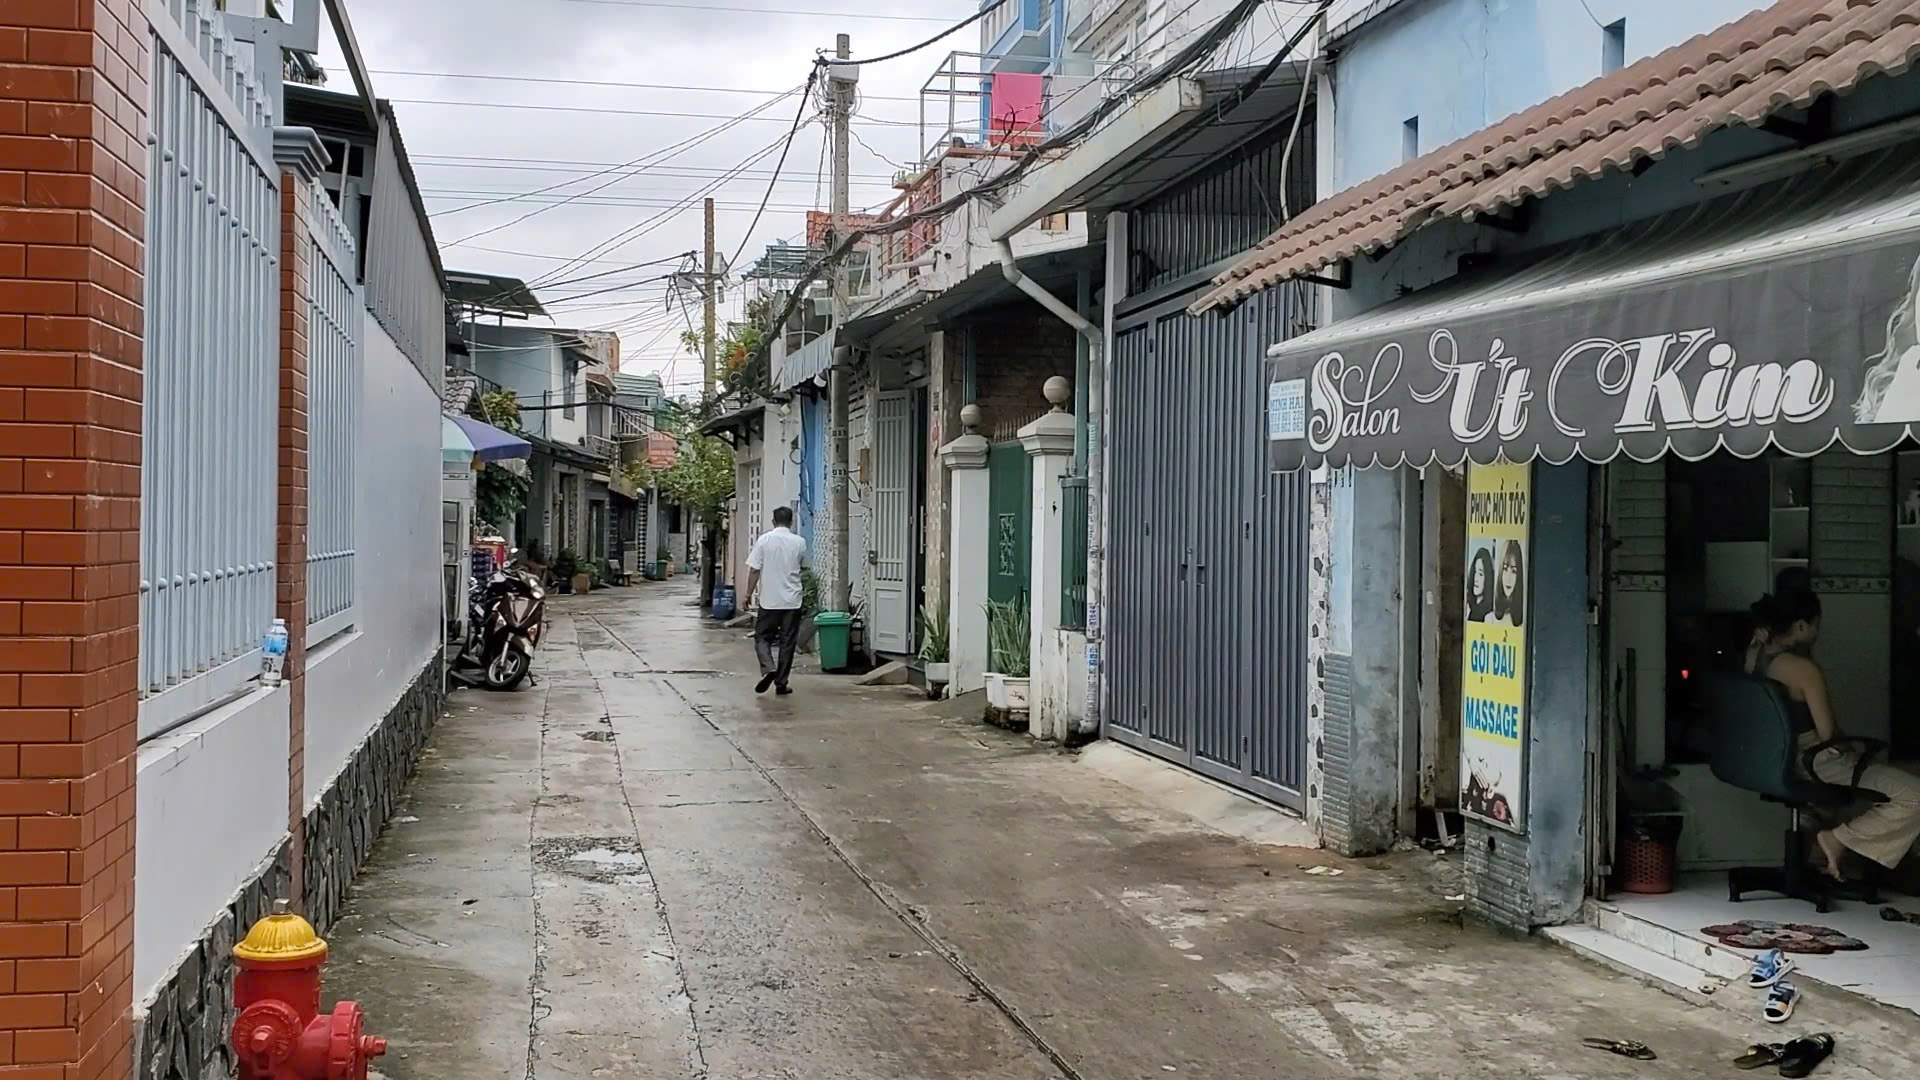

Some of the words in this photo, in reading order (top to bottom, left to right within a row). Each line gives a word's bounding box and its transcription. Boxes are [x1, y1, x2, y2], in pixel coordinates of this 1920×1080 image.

[1308, 342, 1403, 453] Salon
[1408, 328, 1535, 443] Út
[1548, 327, 1835, 437] Kim
[1470, 492, 1491, 533] PHỤC
[1509, 482, 1525, 525] TÓC
[1471, 634, 1490, 683] GỘI
[1465, 697, 1518, 739] MASSAGE
